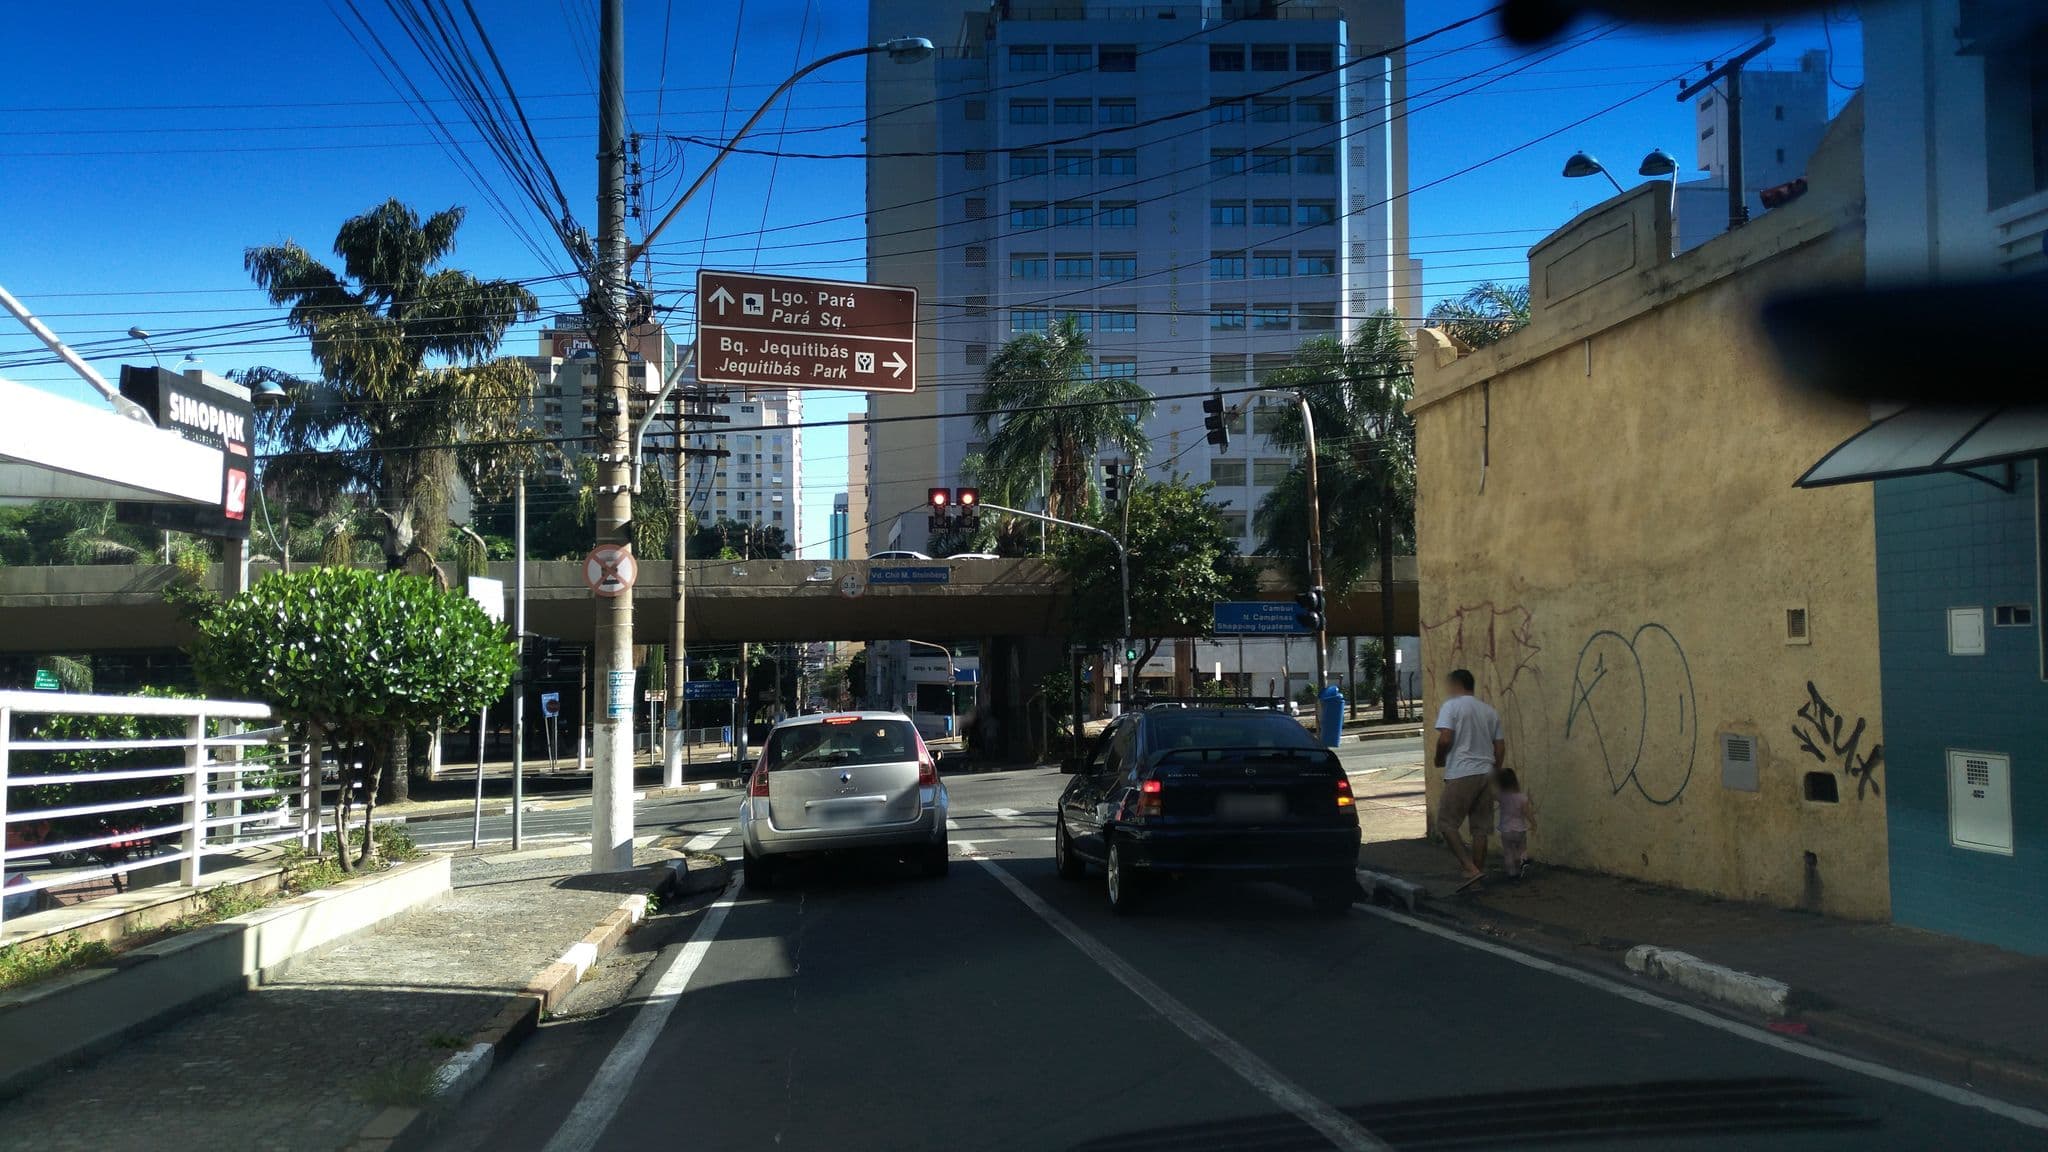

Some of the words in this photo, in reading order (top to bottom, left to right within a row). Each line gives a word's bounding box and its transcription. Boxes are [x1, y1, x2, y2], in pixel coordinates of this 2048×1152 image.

[771, 288, 809, 306] Lgo.
[818, 291, 855, 308] Pará
[771, 308, 810, 325] Pará
[820, 312, 846, 330] Sq.
[720, 336, 749, 356] Bq.
[760, 340, 849, 359] Jequitibás
[719, 358, 801, 377] Jequitibás
[813, 363, 848, 379] Park
[169, 392, 245, 448] SIMOPARK
[1217, 623, 1256, 631] Shopping
